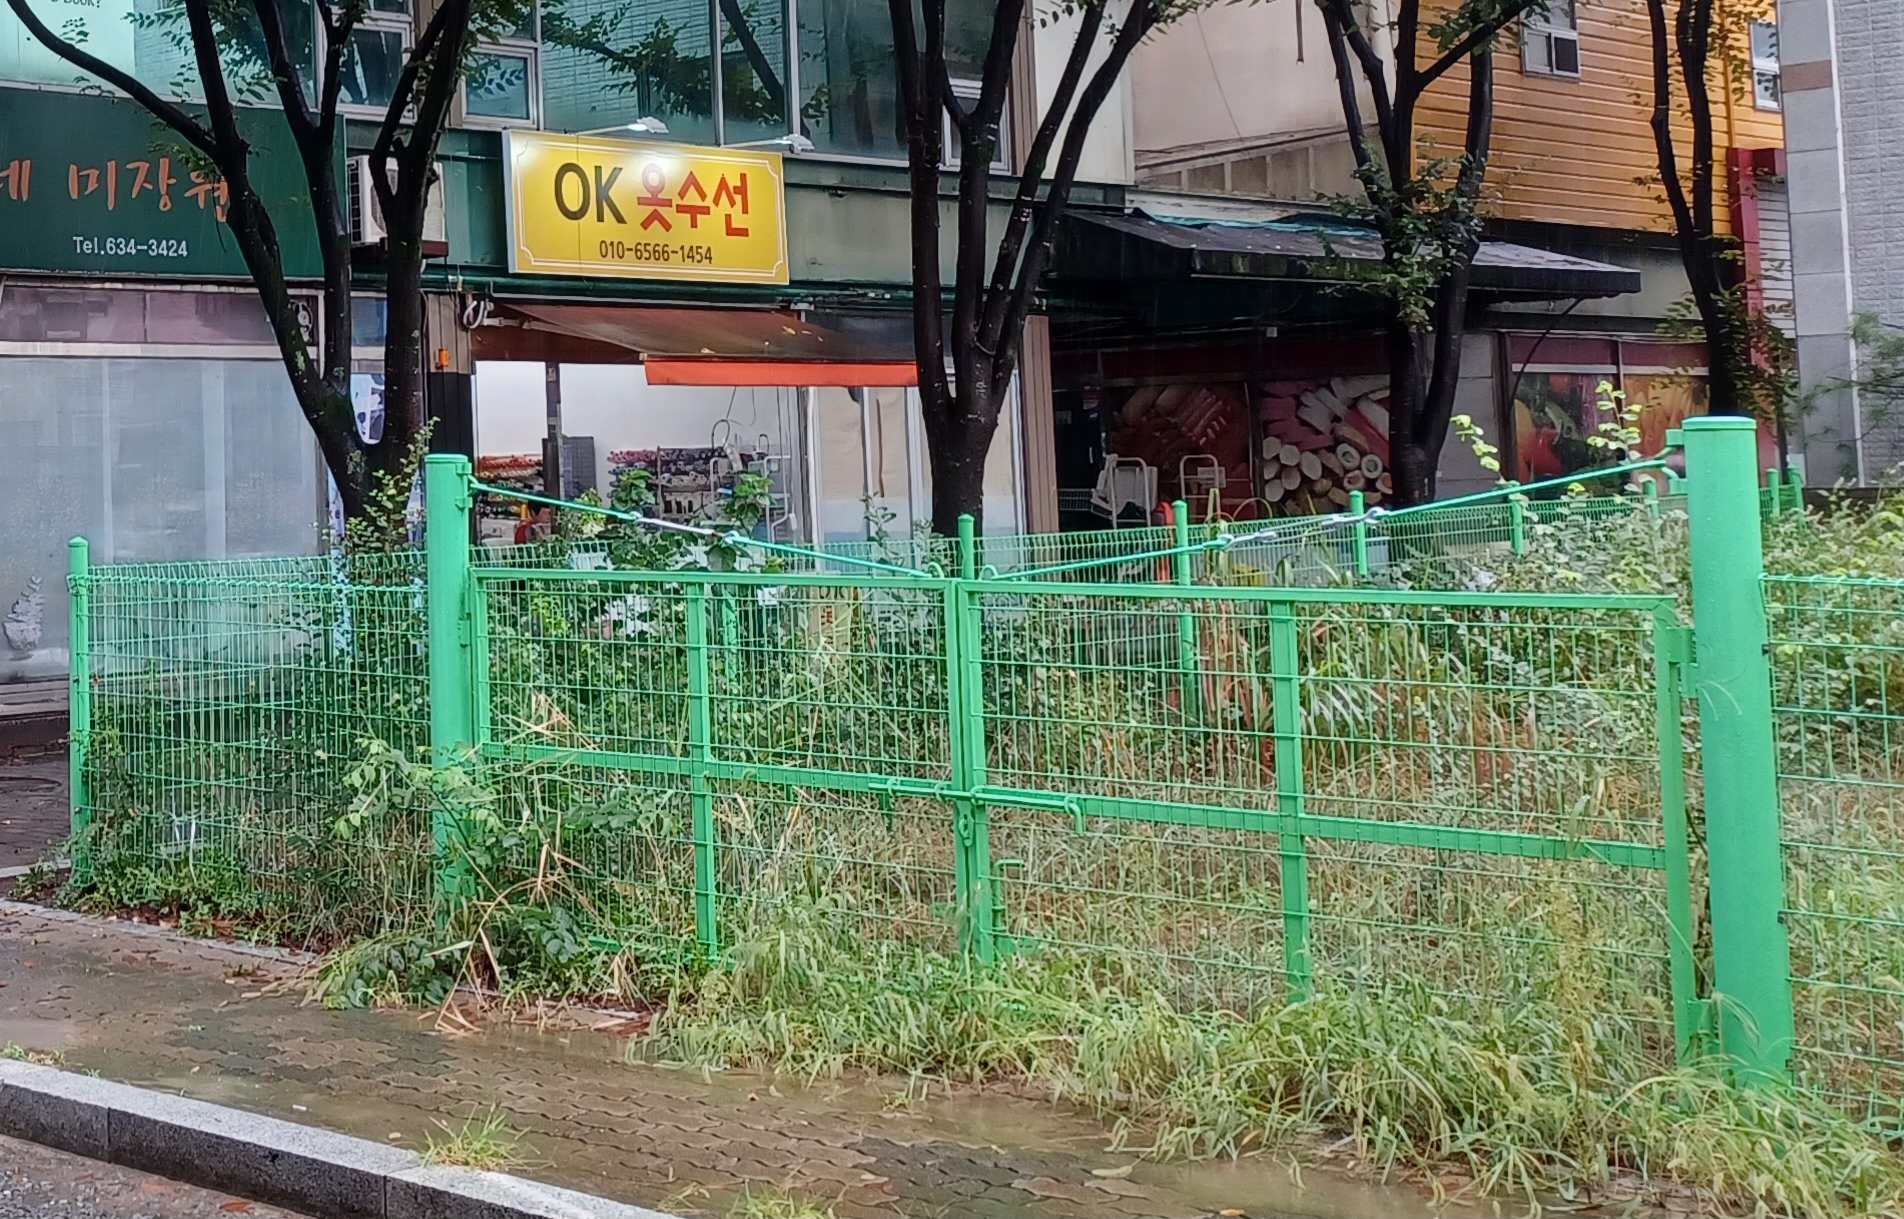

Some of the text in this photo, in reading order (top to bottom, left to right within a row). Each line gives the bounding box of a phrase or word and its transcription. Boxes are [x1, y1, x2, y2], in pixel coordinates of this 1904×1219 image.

[68, 157, 229, 223] 미장원
[554, 162, 749, 237] OK 옷수선
[72, 235, 188, 258] Tel.634-3424
[599, 239, 713, 264] 010-6566-1454
